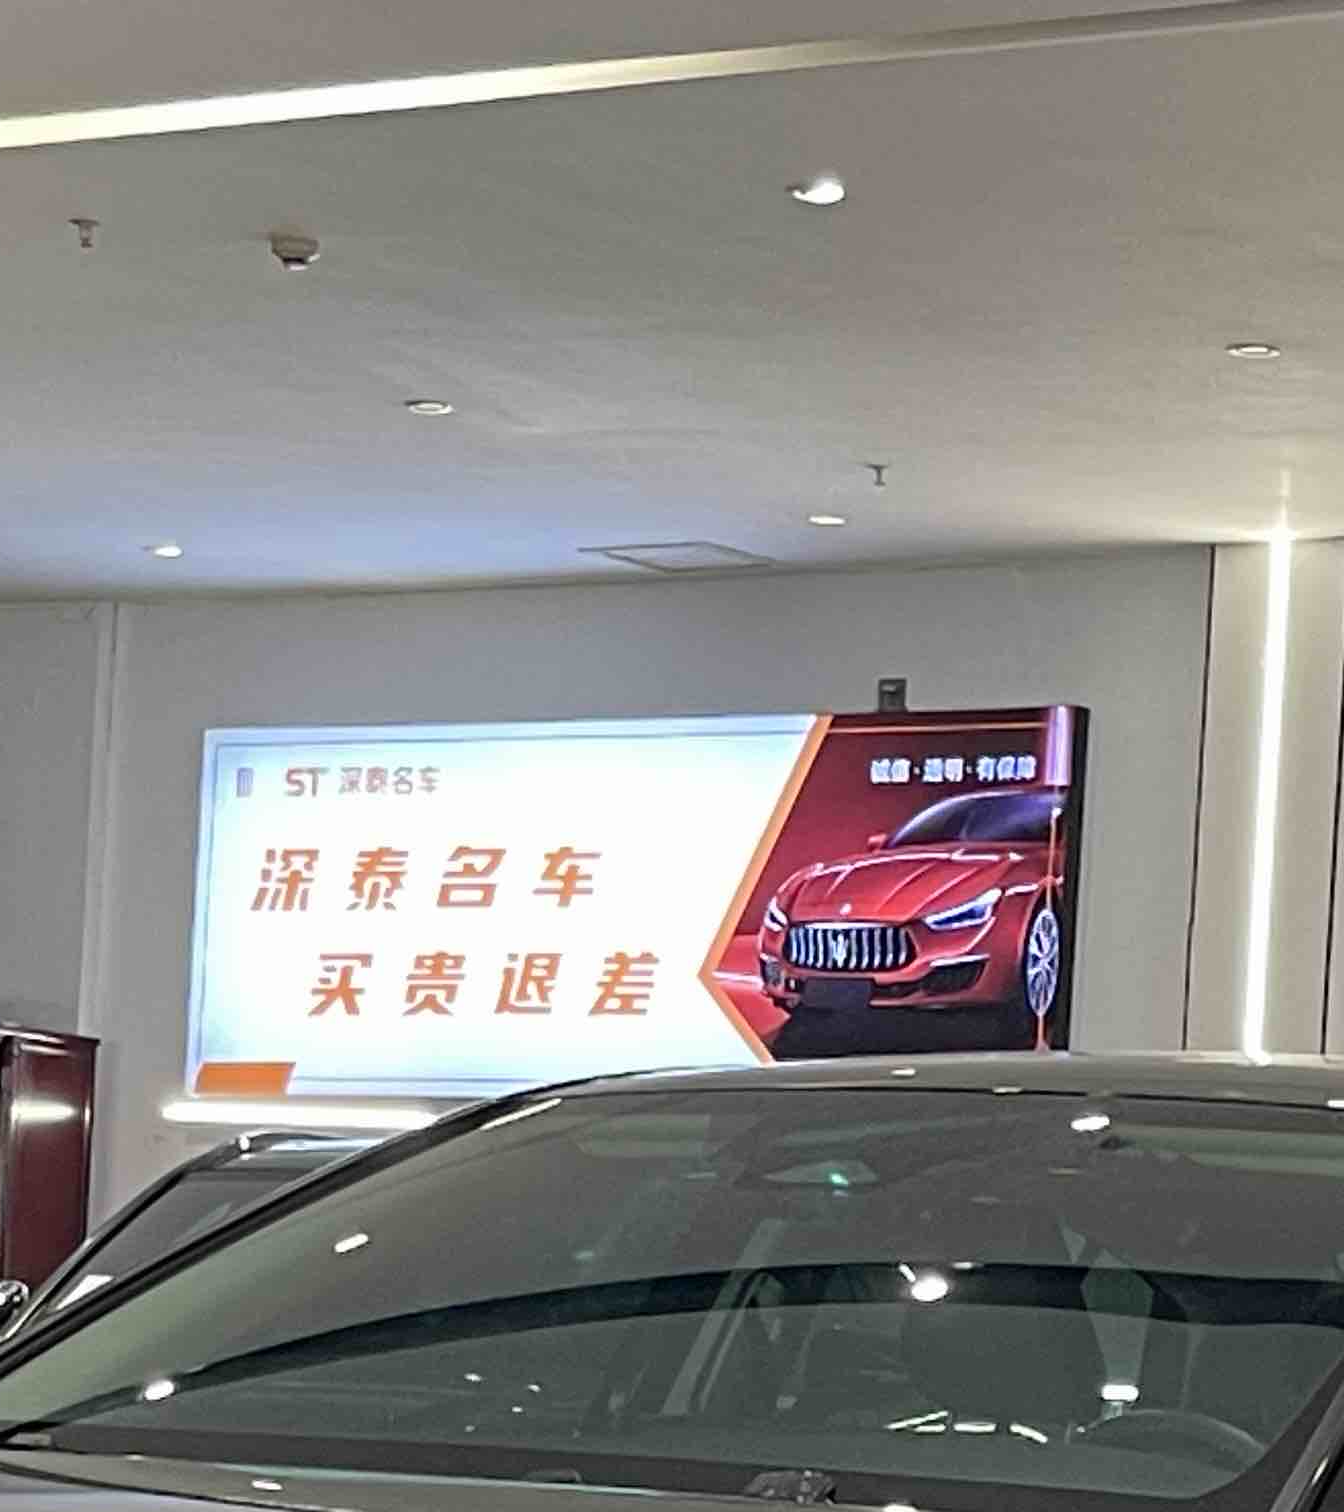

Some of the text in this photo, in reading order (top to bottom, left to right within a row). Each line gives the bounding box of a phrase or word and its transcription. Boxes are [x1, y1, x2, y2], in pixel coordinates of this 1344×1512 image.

[284, 766, 440, 797] ST 深泰名车
[250, 846, 602, 912] 深泰名车
[308, 951, 660, 1017] 买贵退差
